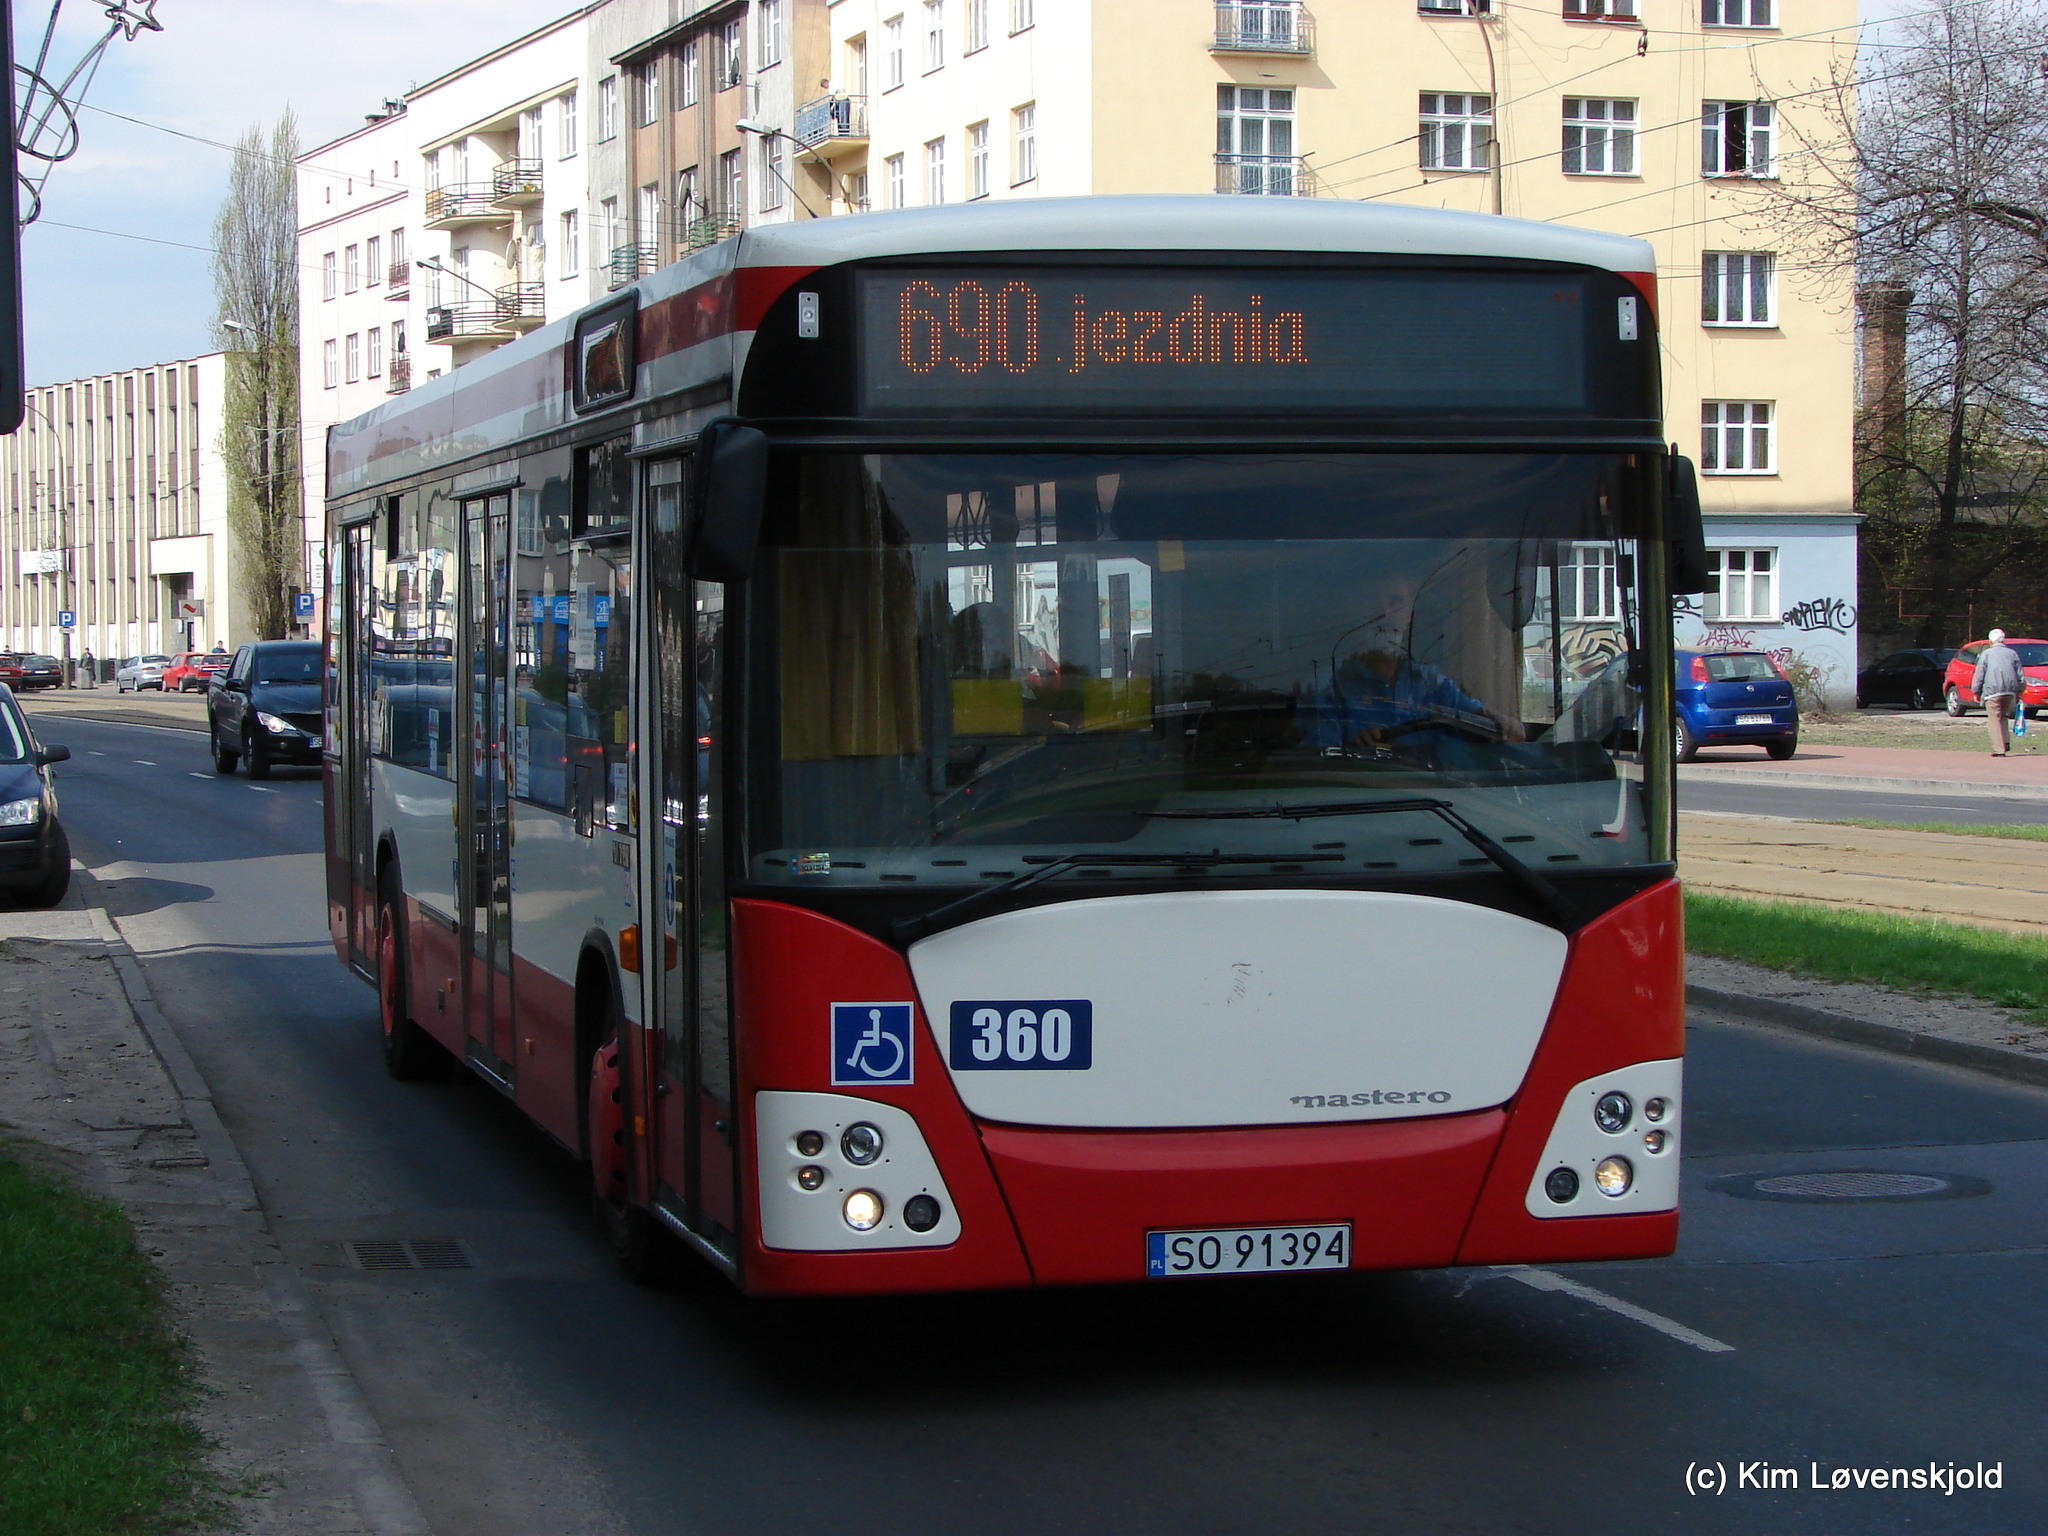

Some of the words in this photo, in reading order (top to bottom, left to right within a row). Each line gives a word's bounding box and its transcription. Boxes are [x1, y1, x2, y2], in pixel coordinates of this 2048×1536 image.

[900, 281, 1037, 373] 690
[300, 595, 311, 610] P
[62, 613, 72, 625] P
[972, 1008, 1072, 1062] 360
[1289, 1089, 1452, 1109] mastero
[1151, 1259, 1164, 1269] PL
[1171, 1236, 1222, 1271] SO
[1235, 1230, 1345, 1268] 91394
